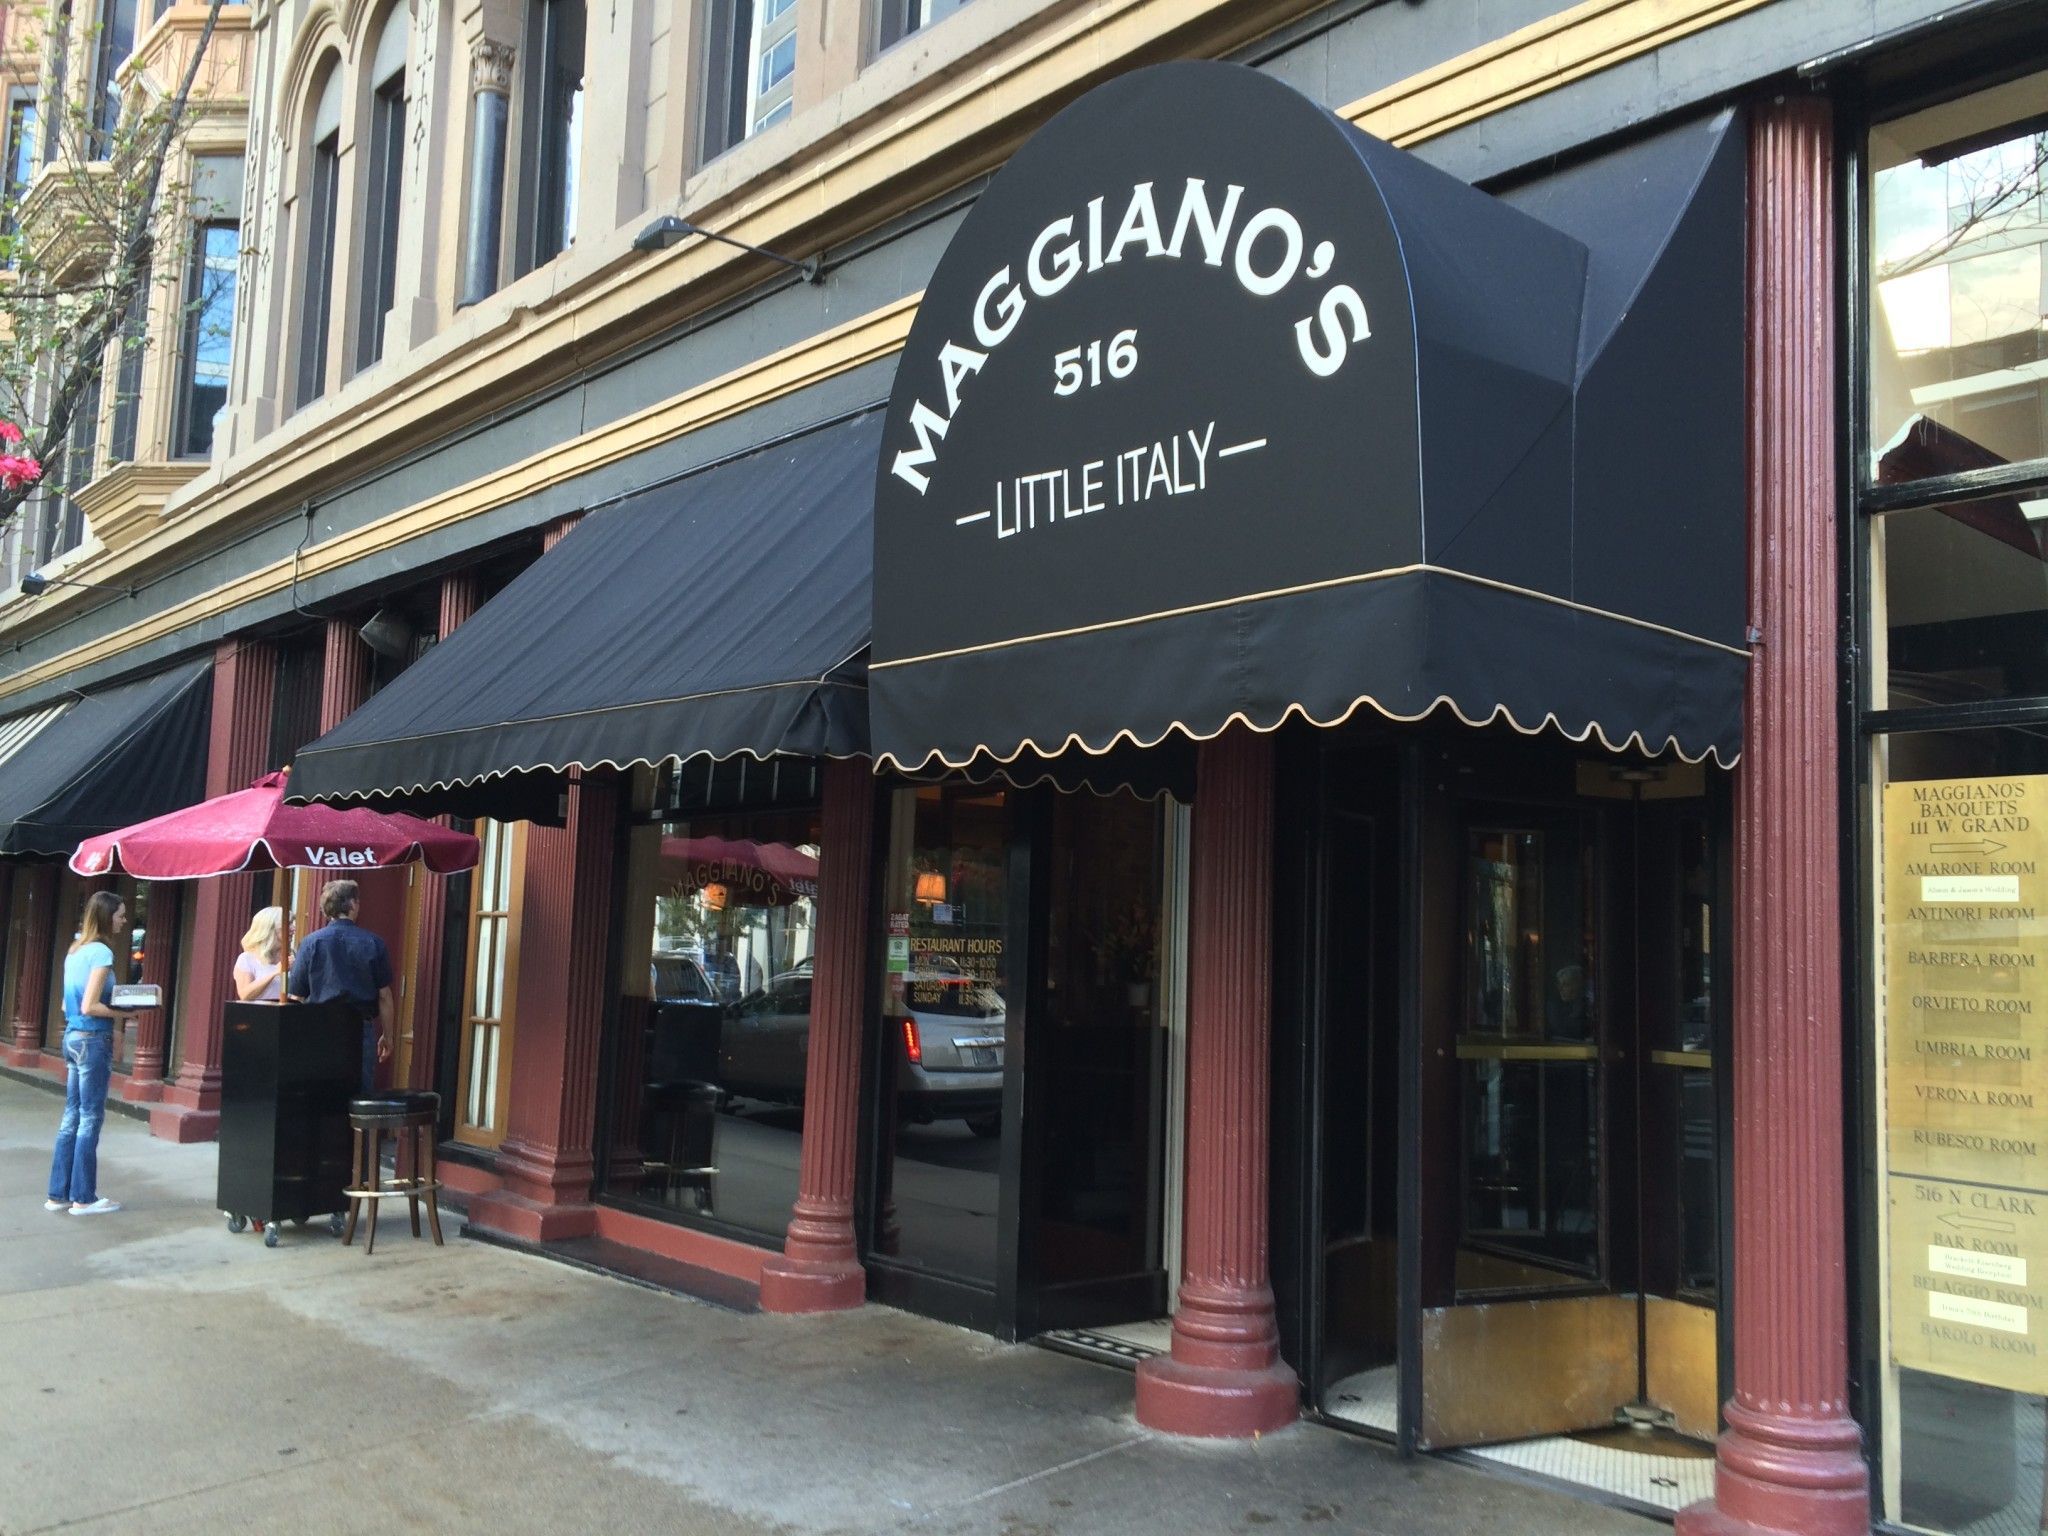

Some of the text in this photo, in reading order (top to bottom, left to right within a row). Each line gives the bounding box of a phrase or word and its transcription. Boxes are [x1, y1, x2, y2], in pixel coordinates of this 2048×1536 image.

[891, 177, 1371, 495] MAGGIANO'S
[1053, 329, 1138, 396] 516
[997, 421, 1216, 539] LITTLE ITALY
[1913, 782, 2025, 801] MAGGIANO'S
[1920, 800, 2018, 818] BANQUETS
[1961, 817, 2030, 833] GRAND
[305, 846, 378, 866] Valet
[1904, 861, 2036, 876] AMARONE ROOM
[670, 856, 780, 907] MAGGIANO'S
[1907, 907, 2035, 921] ANTINORI ROOM
[911, 938, 1002, 954] RESTAURANT HOURS
[1908, 951, 2035, 967] BARBERA ROOM
[1912, 996, 2032, 1014] ORVIETO ROOM
[1915, 1040, 2031, 1060] UMBRIA ROOM
[1915, 1084, 2034, 1108] VERONA ROOM
[1913, 1129, 2037, 1156] RUBESCO ROOM
[1915, 1184, 1943, 1202] 516
[1971, 1192, 2036, 1216] CLARK
[1933, 1232, 2019, 1257] BAR ROOM
[1912, 1274, 2044, 1310] BELAGGIO ROOM
[1920, 1322, 2037, 1357] BAROLO ROOM
